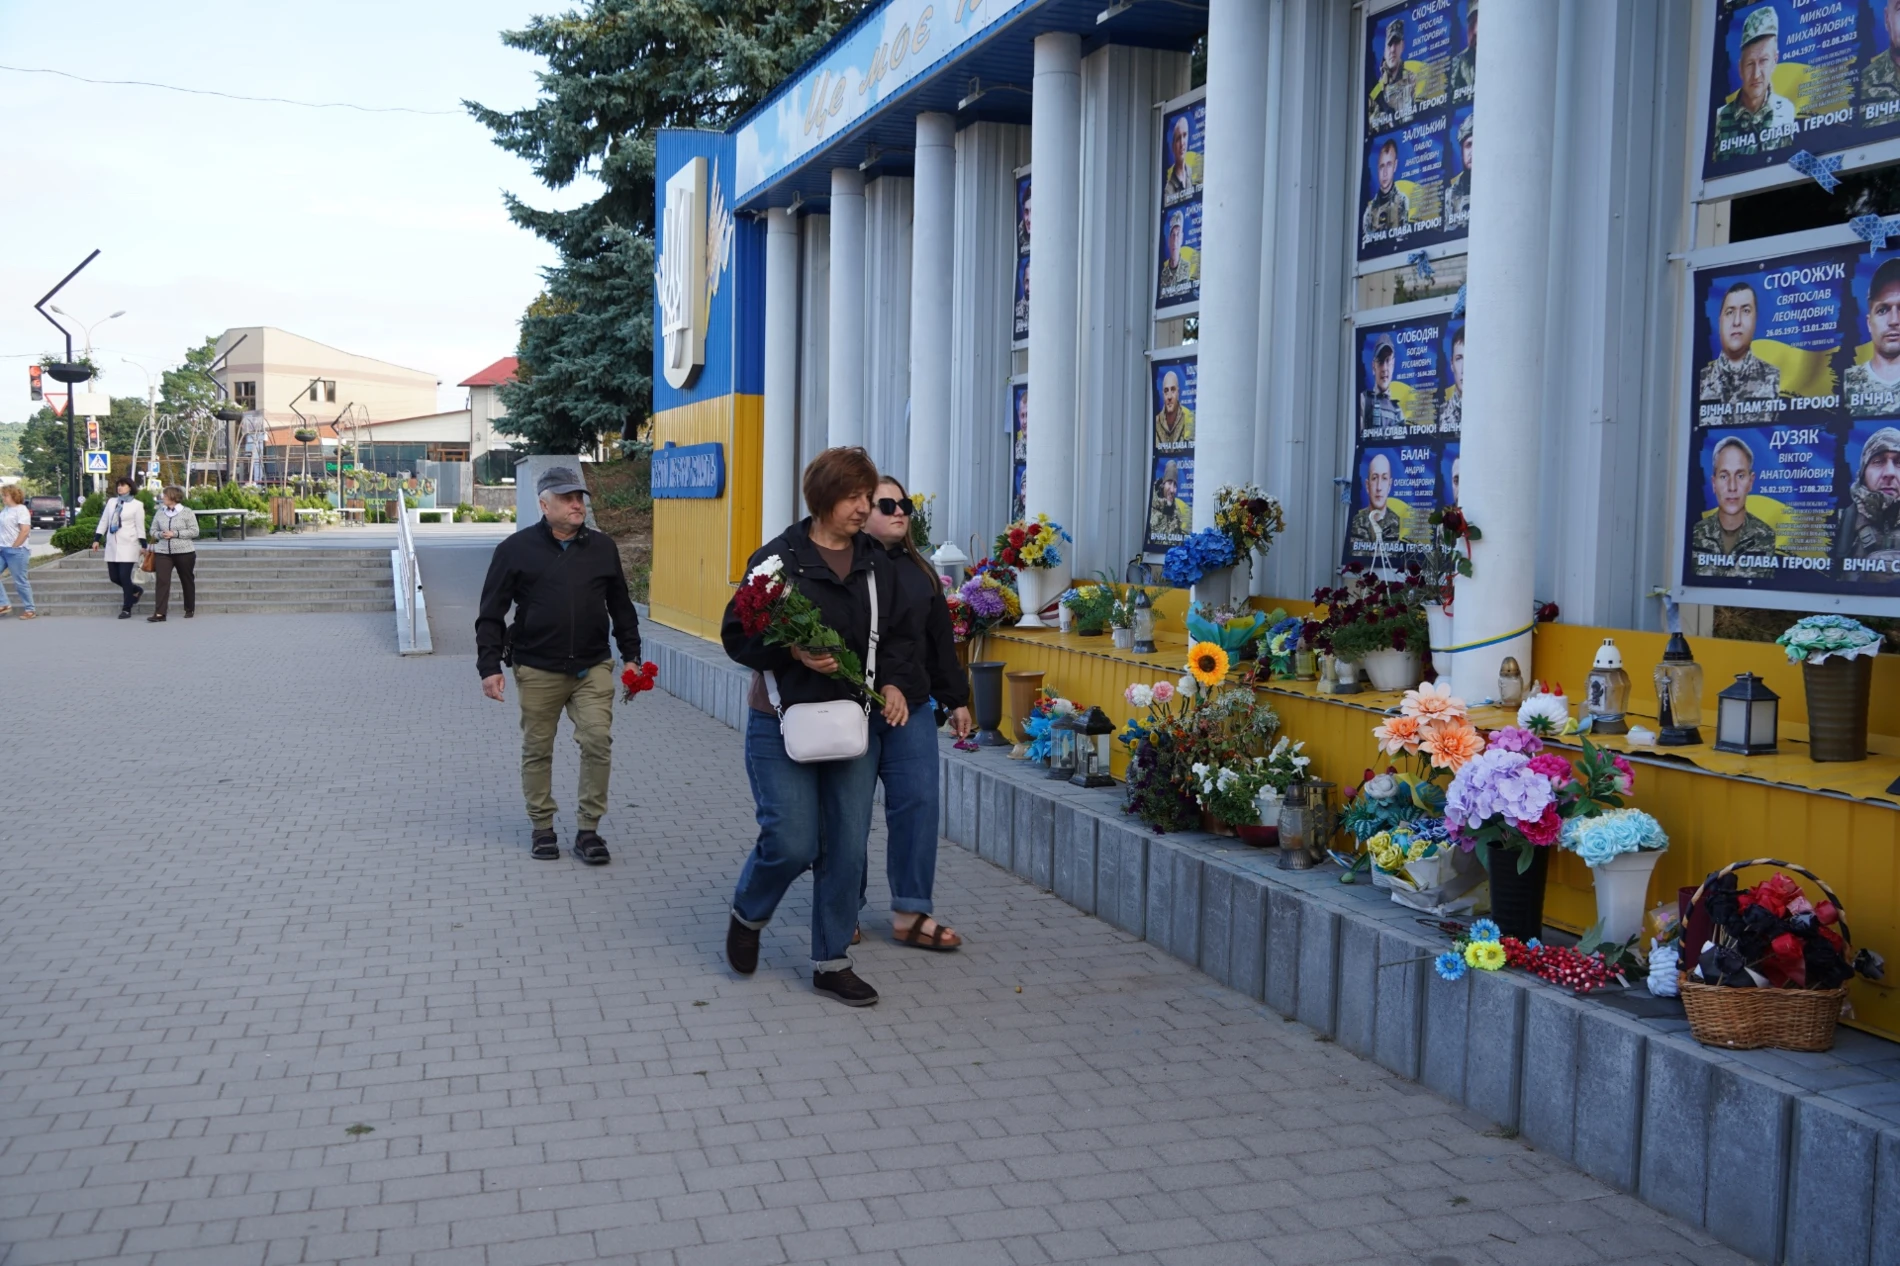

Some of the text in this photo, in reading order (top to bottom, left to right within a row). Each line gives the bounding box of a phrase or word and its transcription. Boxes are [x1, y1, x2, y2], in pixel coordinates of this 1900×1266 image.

[1800, 2, 1842, 24] МИКОЛА
[1786, 14, 1855, 45] МИХАЙЛОВИЧ
[804, 5, 933, 138] Це моє
[1394, 105, 1417, 120] СЛАВА
[1420, 93, 1447, 112] ГЕРОЮ!
[1866, 100, 1900, 119] ВІЧН
[1402, 115, 1447, 143] ЗАЛУЦЬКИЙ
[1720, 108, 1853, 151] ВІЧНА СЛАВА ГЕРОЮ!
[1414, 140, 1432, 152] ПАВЛО
[1388, 225, 1412, 239] СЛАВА
[1414, 217, 1442, 232] ГЕРОЮ!
[1764, 263, 1845, 289] СТОРОЖУК
[1776, 289, 1831, 305] СВЯТОСЛАВ
[1772, 305, 1834, 322] ЛЕОНІДОВИЧ
[1802, 322, 1837, 332] 13.01.2023
[1396, 327, 1439, 344] СЛОБОДЯН
[1407, 346, 1428, 356] БОГДАН
[1402, 358, 1431, 369] РУСЛАНОВИЧ
[1700, 403, 1732, 417] ВІЧНА
[1790, 395, 1839, 410] ГЕРОЮ!
[1851, 392, 1894, 406] ВІЧНА
[1363, 424, 1436, 438] ВІЧНА СЛАВА ГЕРОЮ!
[1770, 429, 1819, 449] ДУЗЯК
[1401, 449, 1430, 460] БАЛАН
[1778, 452, 1813, 463] ВІКТОР
[1405, 465, 1425, 474] АНДРІЙ
[1759, 467, 1834, 480] АНАТОЛІЙОВИЧ
[1394, 478, 1435, 488] ОЛЕКСАНДРОВИЧ
[1353, 542, 1376, 551] ВІЧНА
[1698, 554, 1830, 570] ВІЧНА СЛАВА ГЕРОЮ!
[1843, 558, 1886, 571] ВІЧНА
